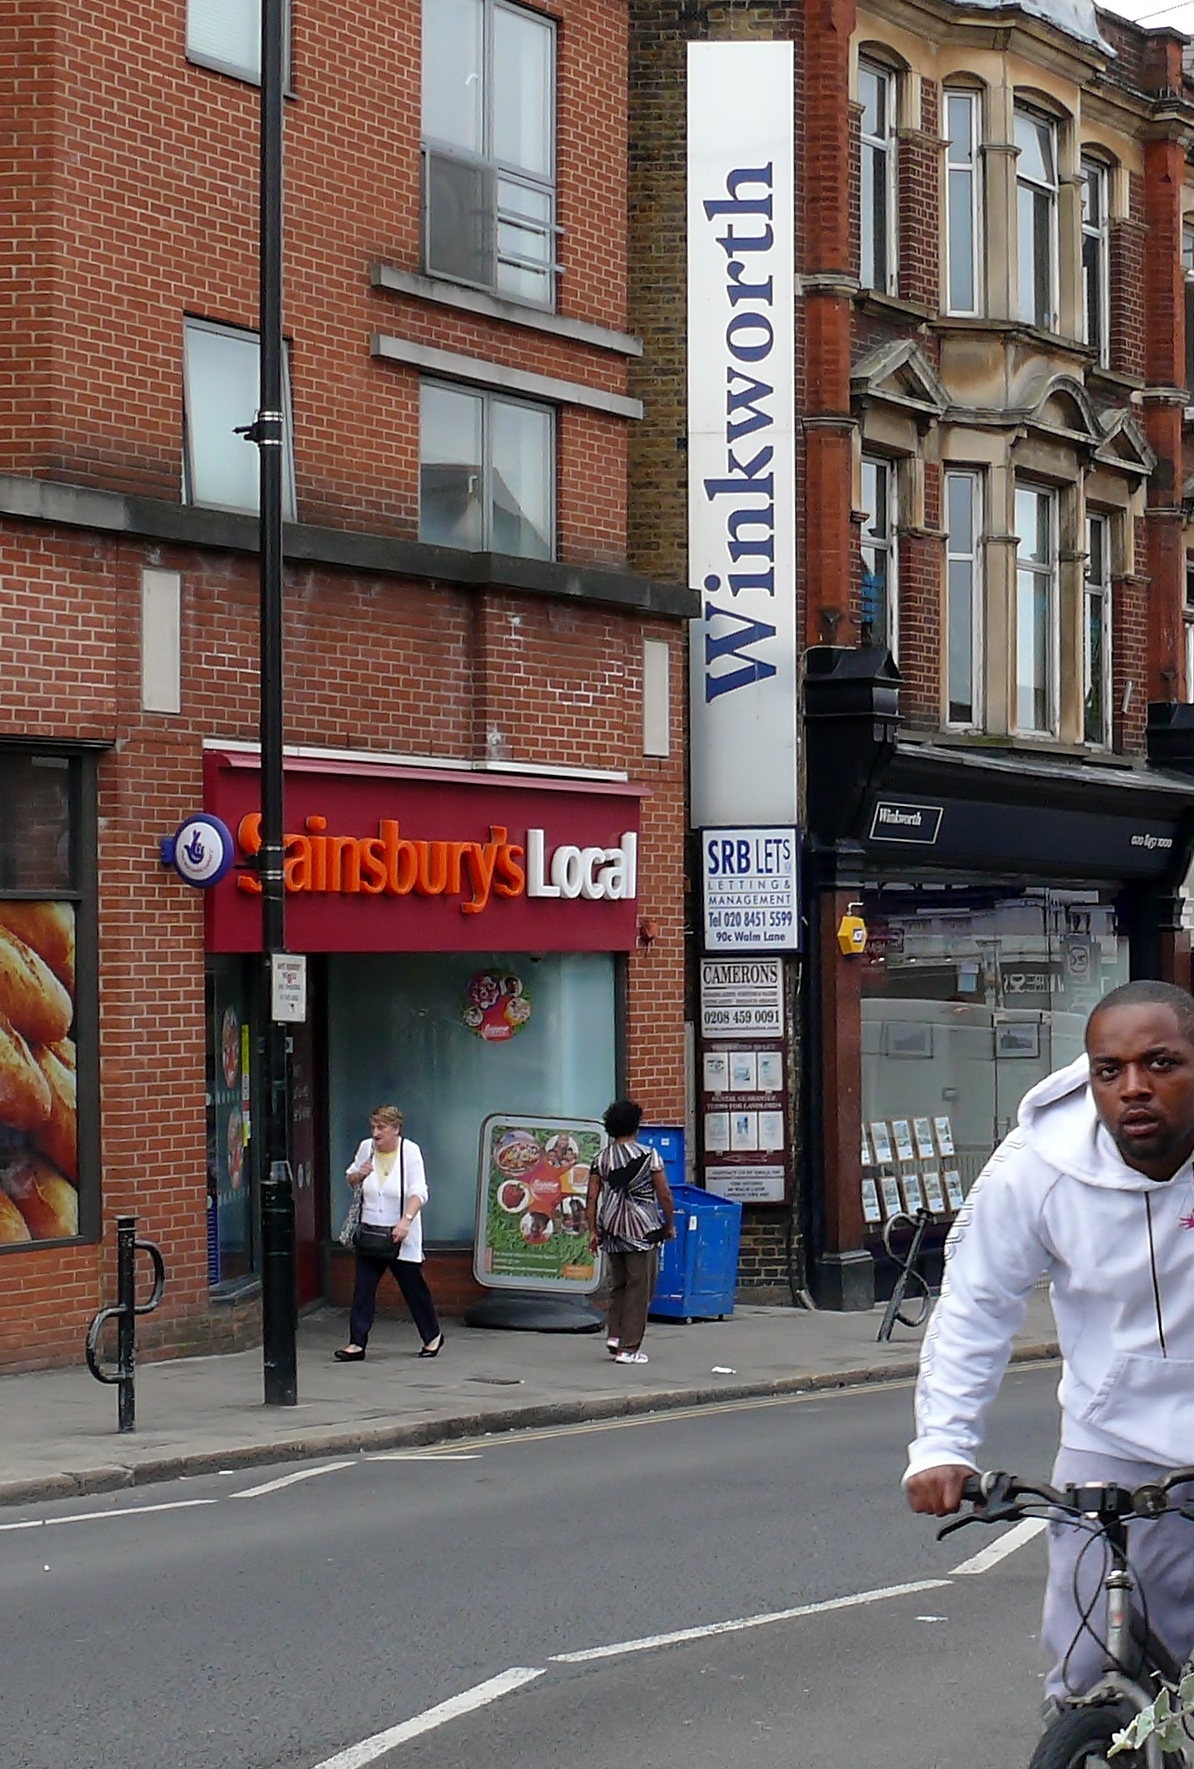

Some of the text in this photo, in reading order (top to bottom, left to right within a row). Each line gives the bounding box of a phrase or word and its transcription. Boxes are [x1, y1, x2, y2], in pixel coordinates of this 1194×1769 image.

[703, 161, 777, 703] Winkworth
[879, 808, 922, 826] Winkworth
[527, 828, 638, 900] Local
[708, 839, 791, 875] SRB LETS
[708, 880, 791, 891] LETTING &
[708, 894, 791, 905] MANAGEMENT
[708, 911, 792, 928] Tel 020 8451 5599
[716, 931, 786, 942] 90c Walm Lane
[703, 965, 778, 985] CAMERONS
[704, 1010, 779, 1024] 0208 459 0091
